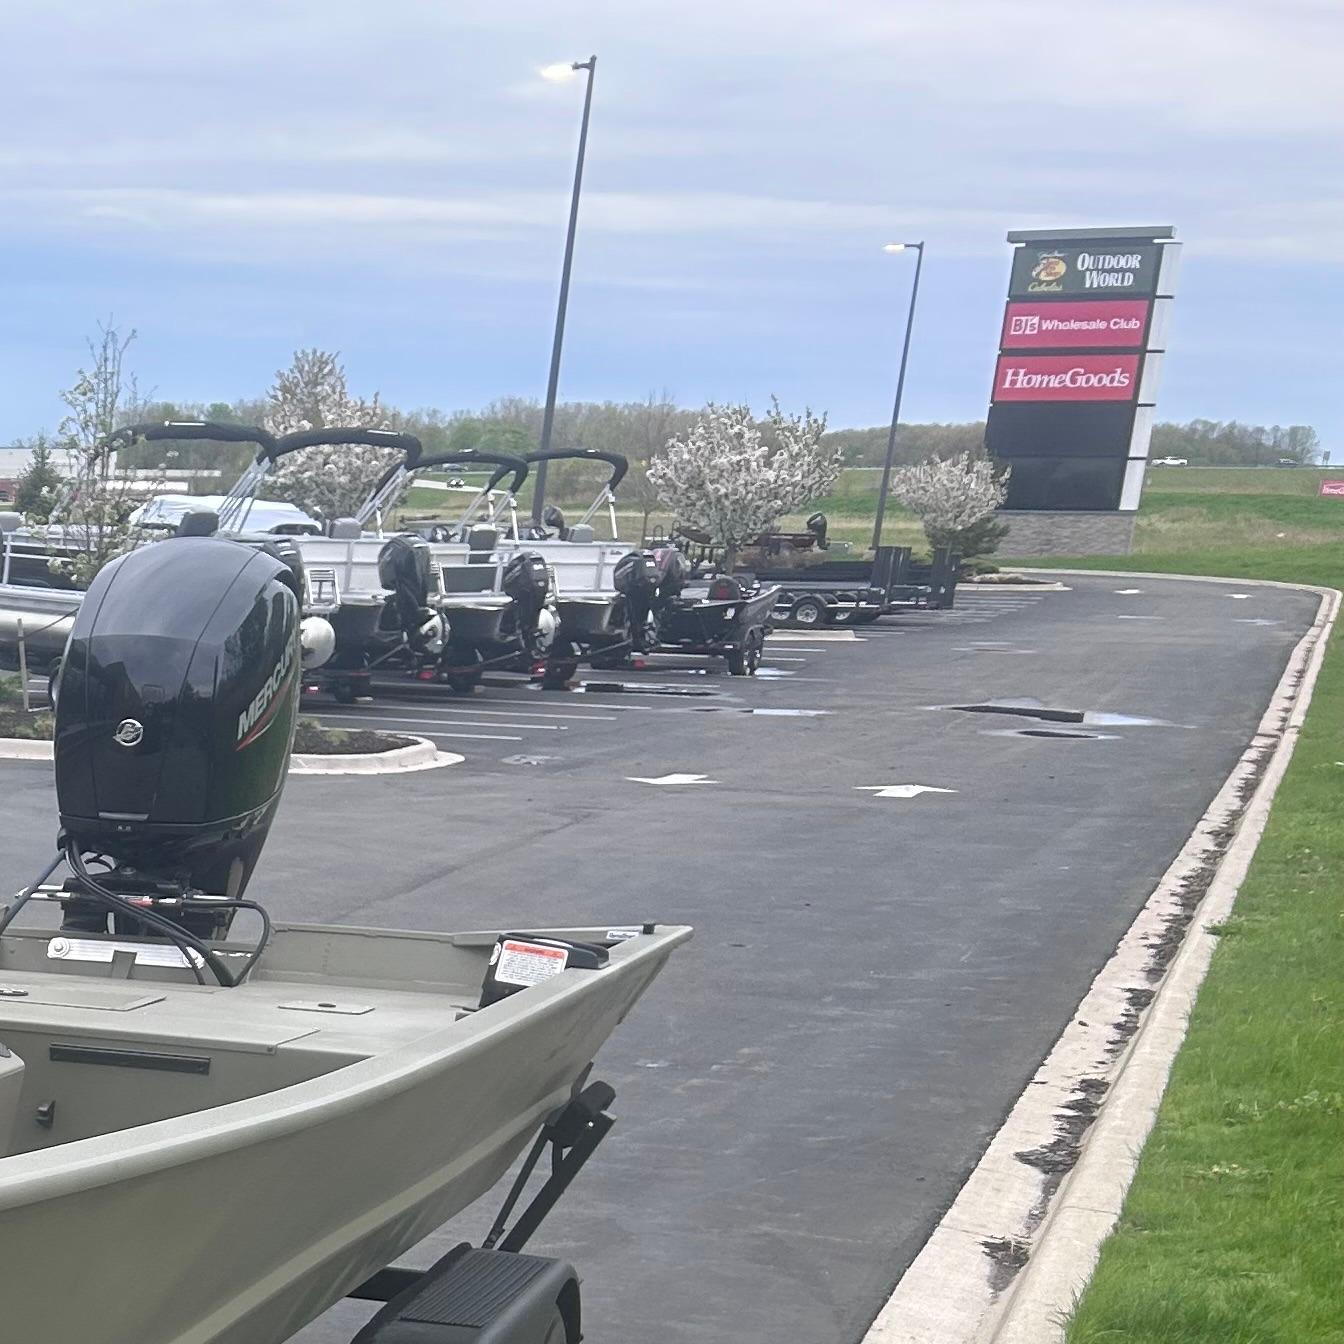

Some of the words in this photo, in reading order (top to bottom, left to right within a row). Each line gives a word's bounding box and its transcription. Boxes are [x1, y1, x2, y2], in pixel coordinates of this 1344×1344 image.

[1077, 253, 1142, 271] OUTDOOR
[1085, 271, 1135, 288] WORLD
[1010, 315, 1039, 335] BJ's
[1041, 318, 1108, 331] Wholesale
[1110, 317, 1141, 330] Club
[1002, 367, 1130, 389] HomeGoods
[237, 633, 297, 740] MERCUR
